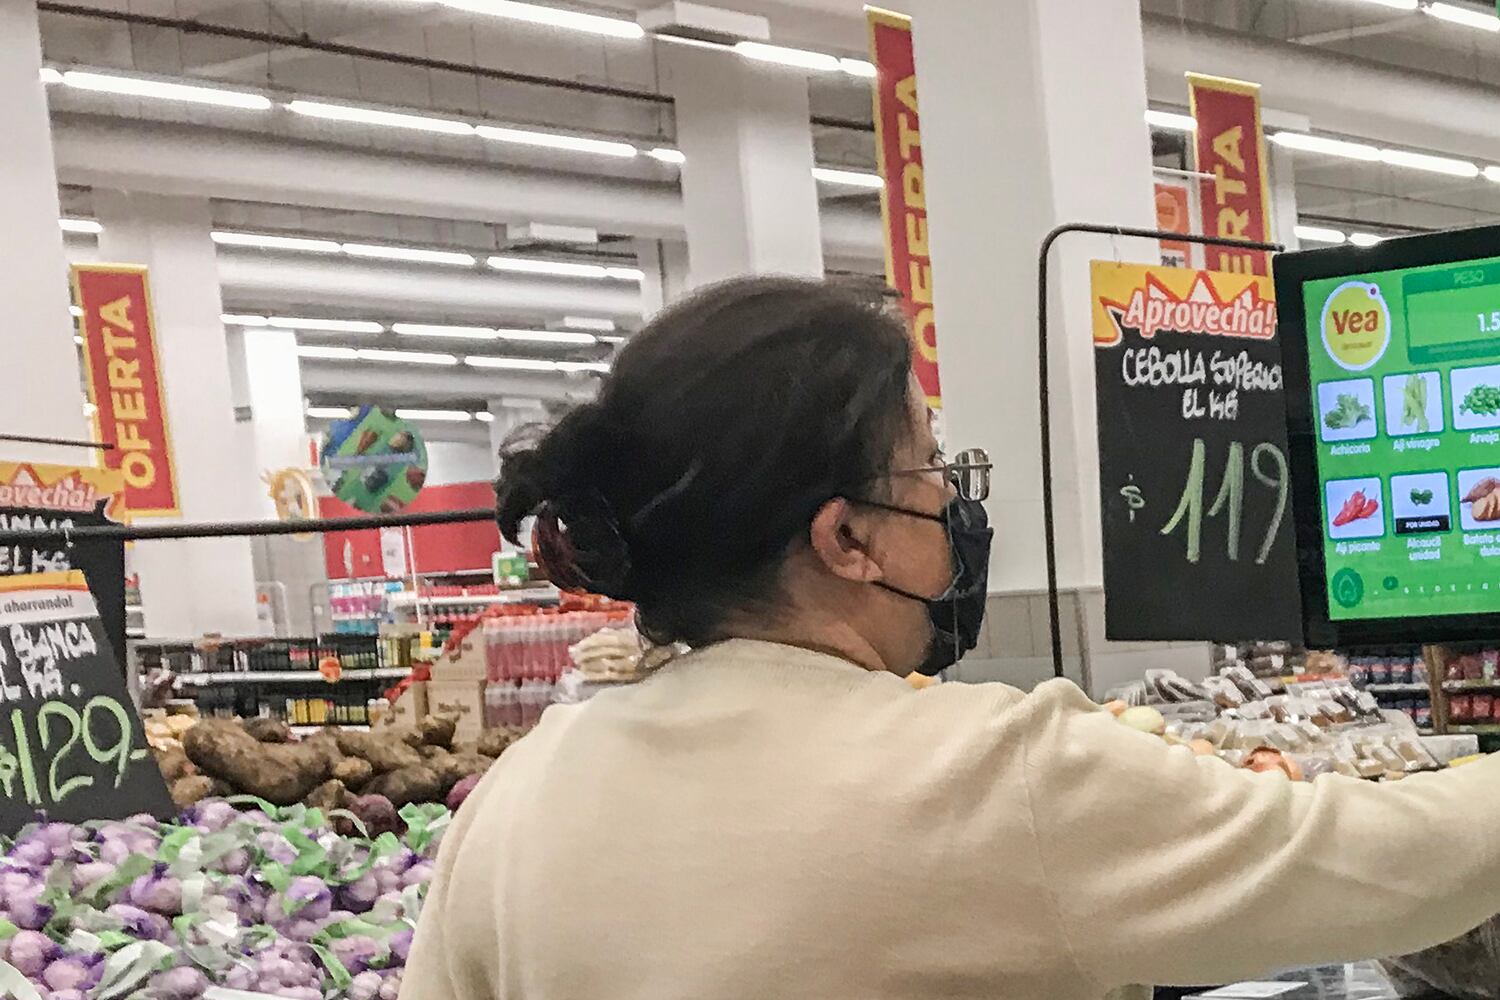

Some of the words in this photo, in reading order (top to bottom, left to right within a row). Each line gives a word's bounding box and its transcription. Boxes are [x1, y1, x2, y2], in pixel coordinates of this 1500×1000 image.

[1126, 289, 1275, 337] Aprovechá!
[1333, 309, 1379, 335] Vea
[1122, 346, 1205, 386] CEBOLLA
[100, 295, 155, 487] OFERTA
[1182, 388, 1205, 419] EL
[1119, 473, 1146, 523] $
[1159, 437, 1289, 566] 119
